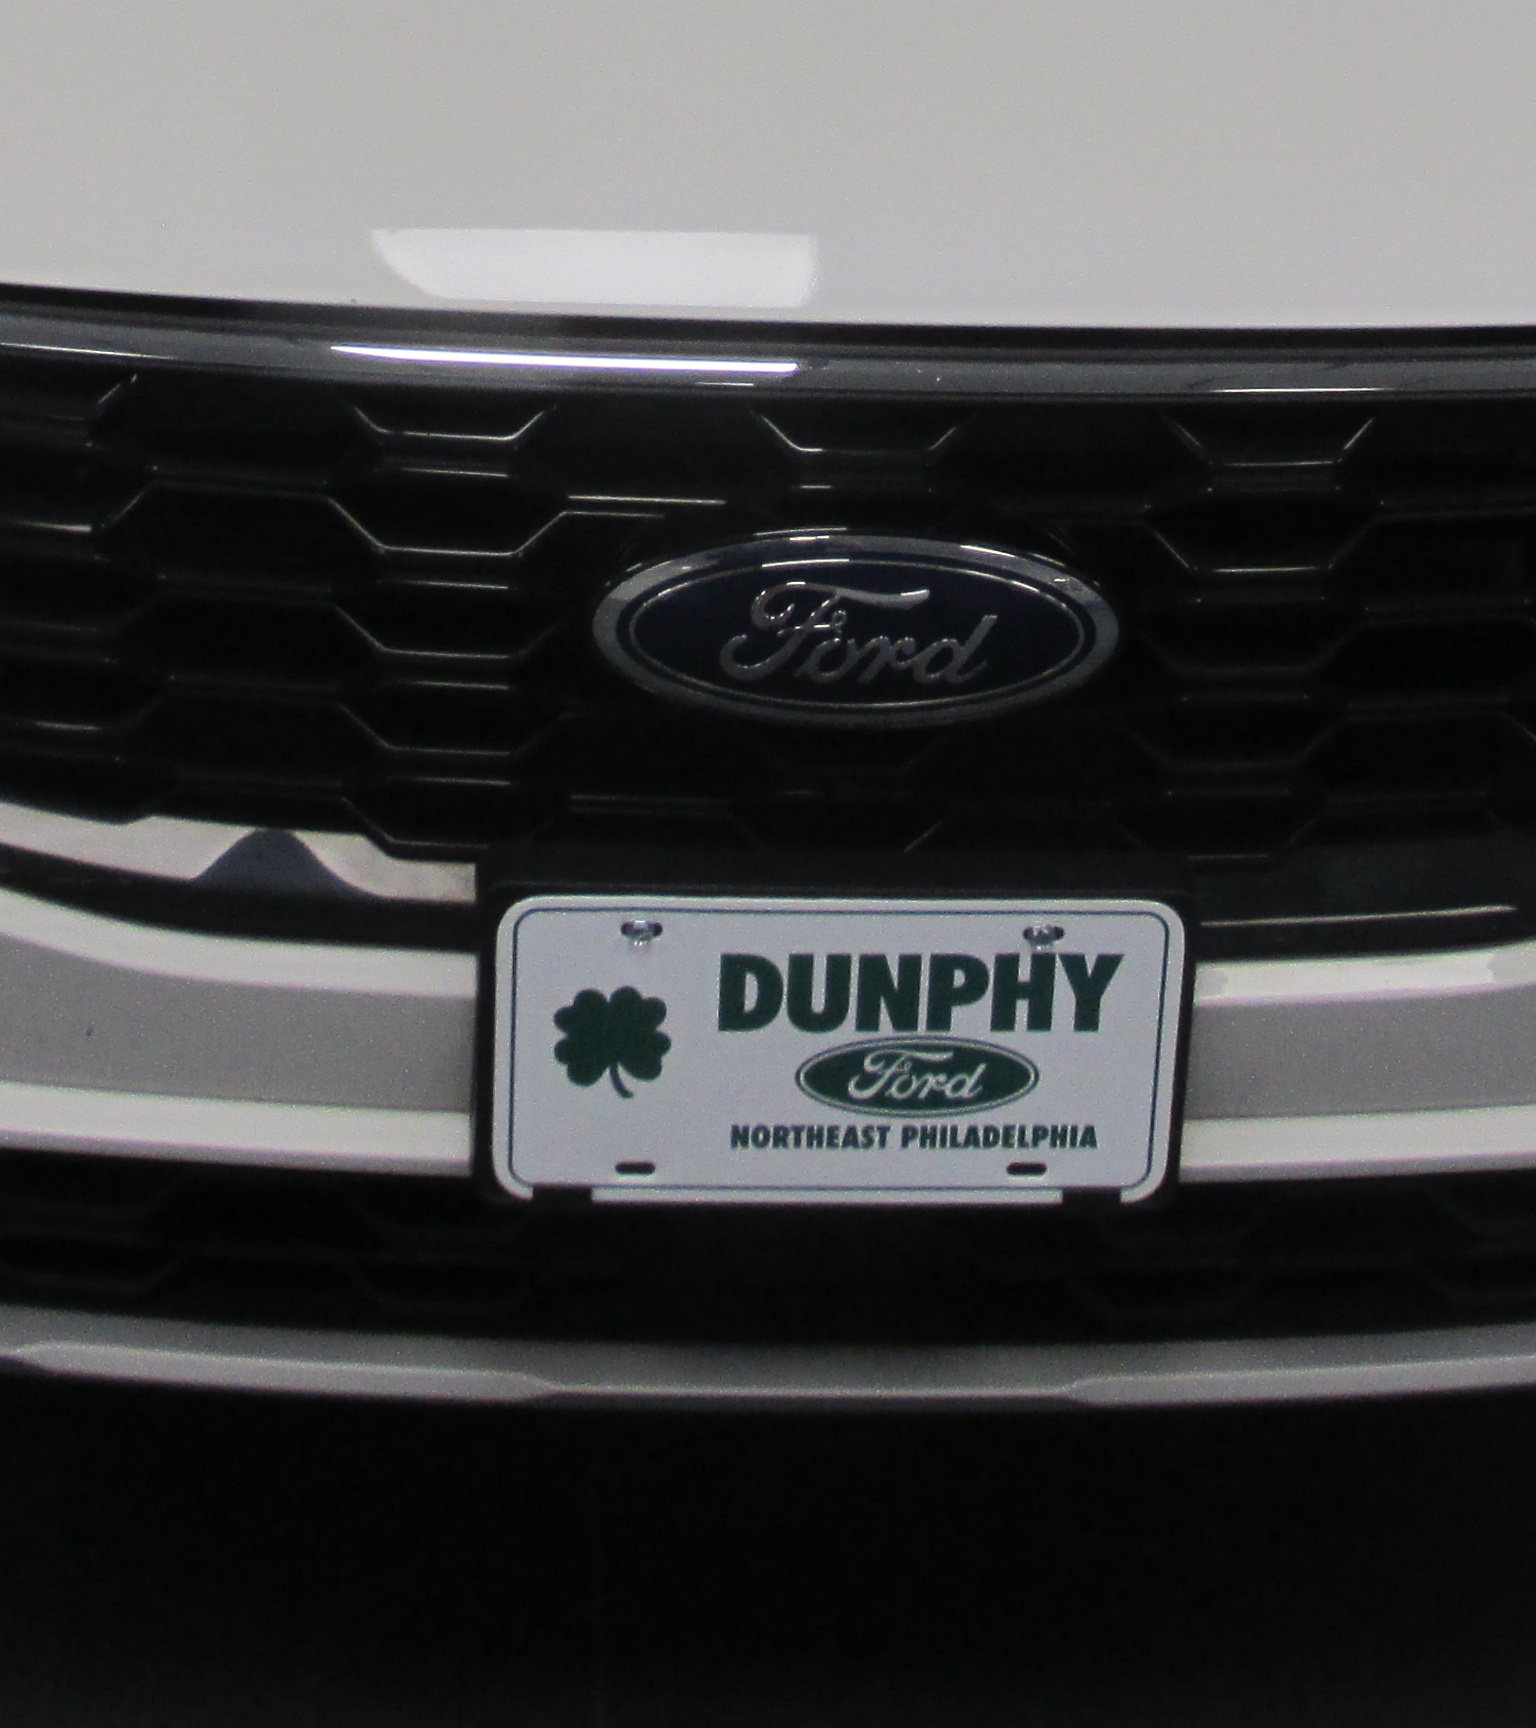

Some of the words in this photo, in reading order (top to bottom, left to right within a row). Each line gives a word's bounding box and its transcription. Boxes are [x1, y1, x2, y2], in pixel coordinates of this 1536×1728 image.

[720, 581, 998, 683] Ford
[718, 953, 1124, 1033] DUNPHY
[848, 1049, 986, 1100] Ford
[730, 1124, 891, 1150] NORTHEAST
[900, 1125, 1098, 1150] PHILADELPHIA
